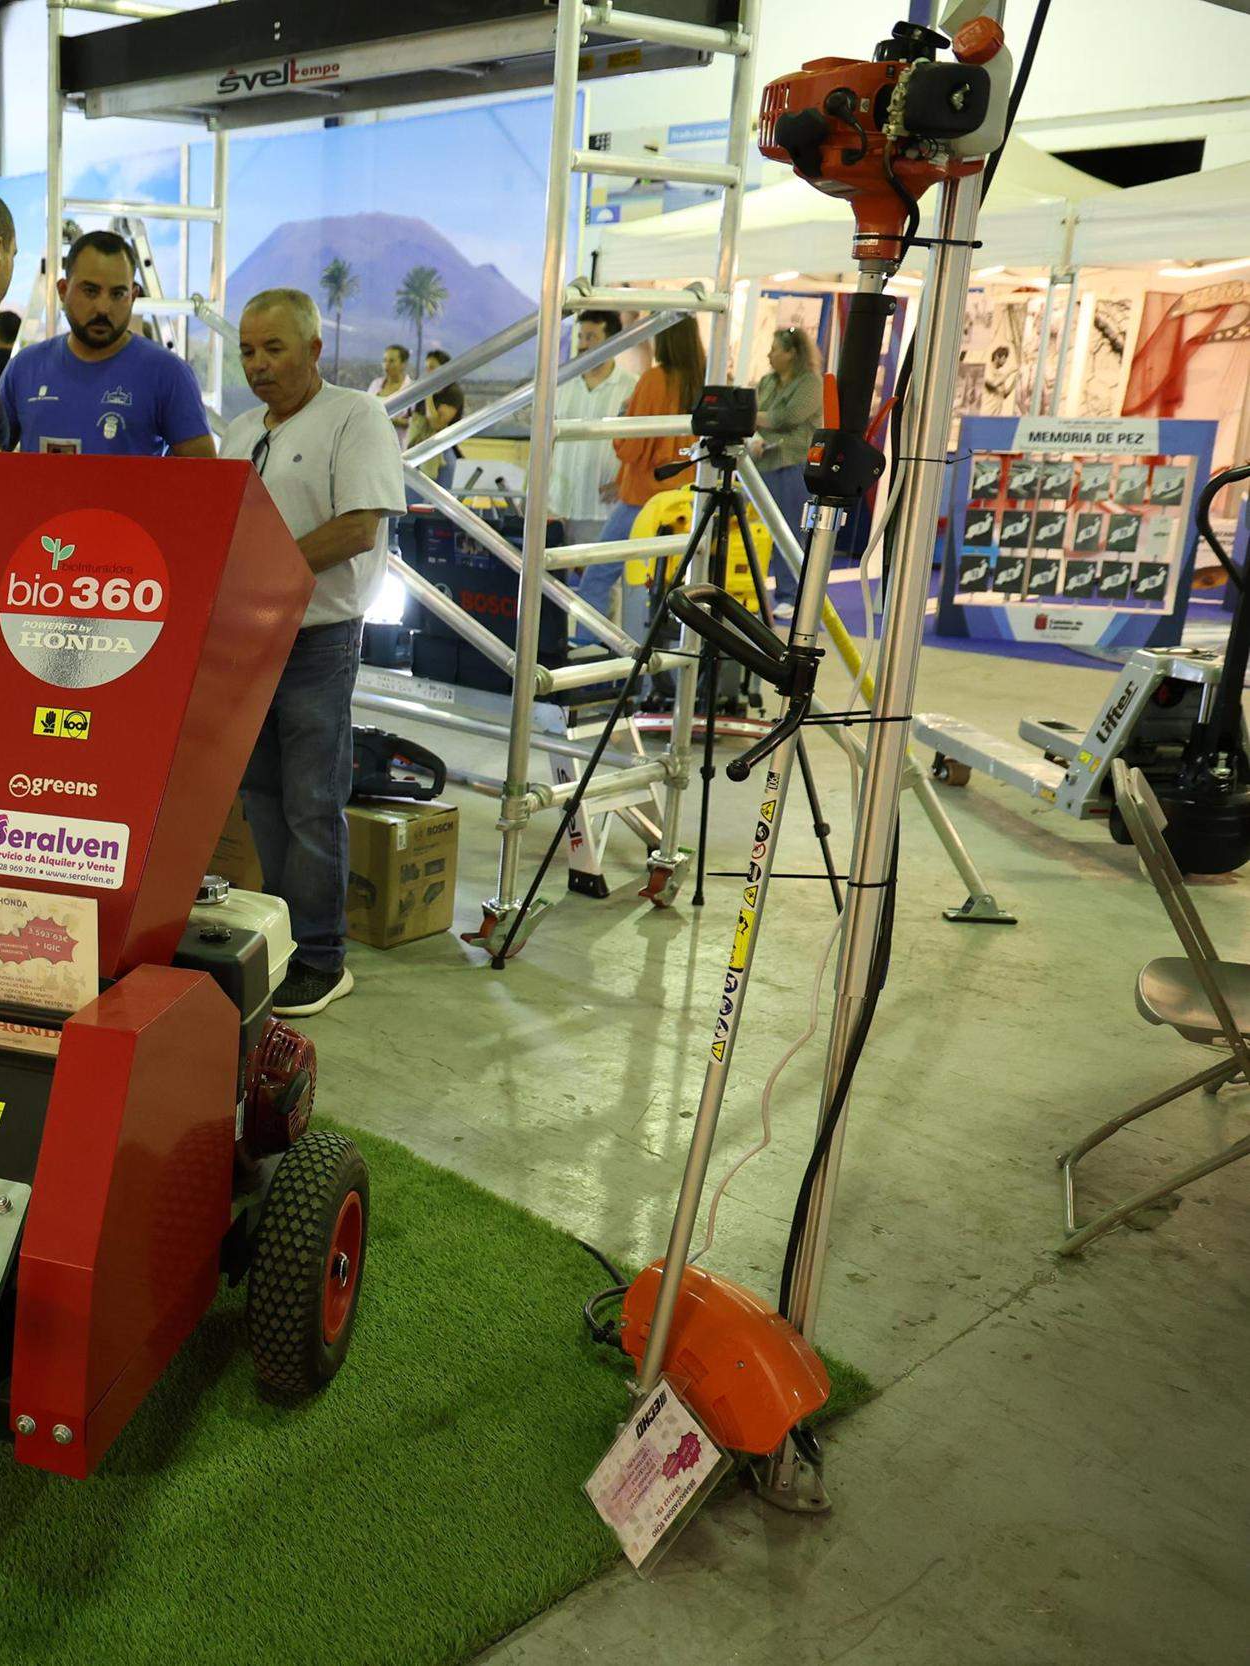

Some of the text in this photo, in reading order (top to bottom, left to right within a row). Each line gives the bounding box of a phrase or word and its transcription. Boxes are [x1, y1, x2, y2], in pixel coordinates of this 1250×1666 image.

[1028, 431, 1145, 445] MEMORIA DE PEZ
[7, 572, 164, 613] bio 360
[21, 620, 94, 634] POWERED by
[18, 631, 137, 654] HONDA
[1095, 680, 1140, 744] Lifter
[30, 777, 98, 797] greens
[426, 821, 455, 837] BOSCH
[25, 853, 37, 863] de
[38, 853, 77, 868] Alquiler
[77, 861, 85, 871] y
[87, 861, 116, 873] Venta
[9, 864, 23, 873] 969
[24, 866, 37, 875] 761
[45, 870, 115, 886] www.seralven.es
[43, 942, 62, 953] IGIC
[635, 1395, 666, 1440] ECHO
